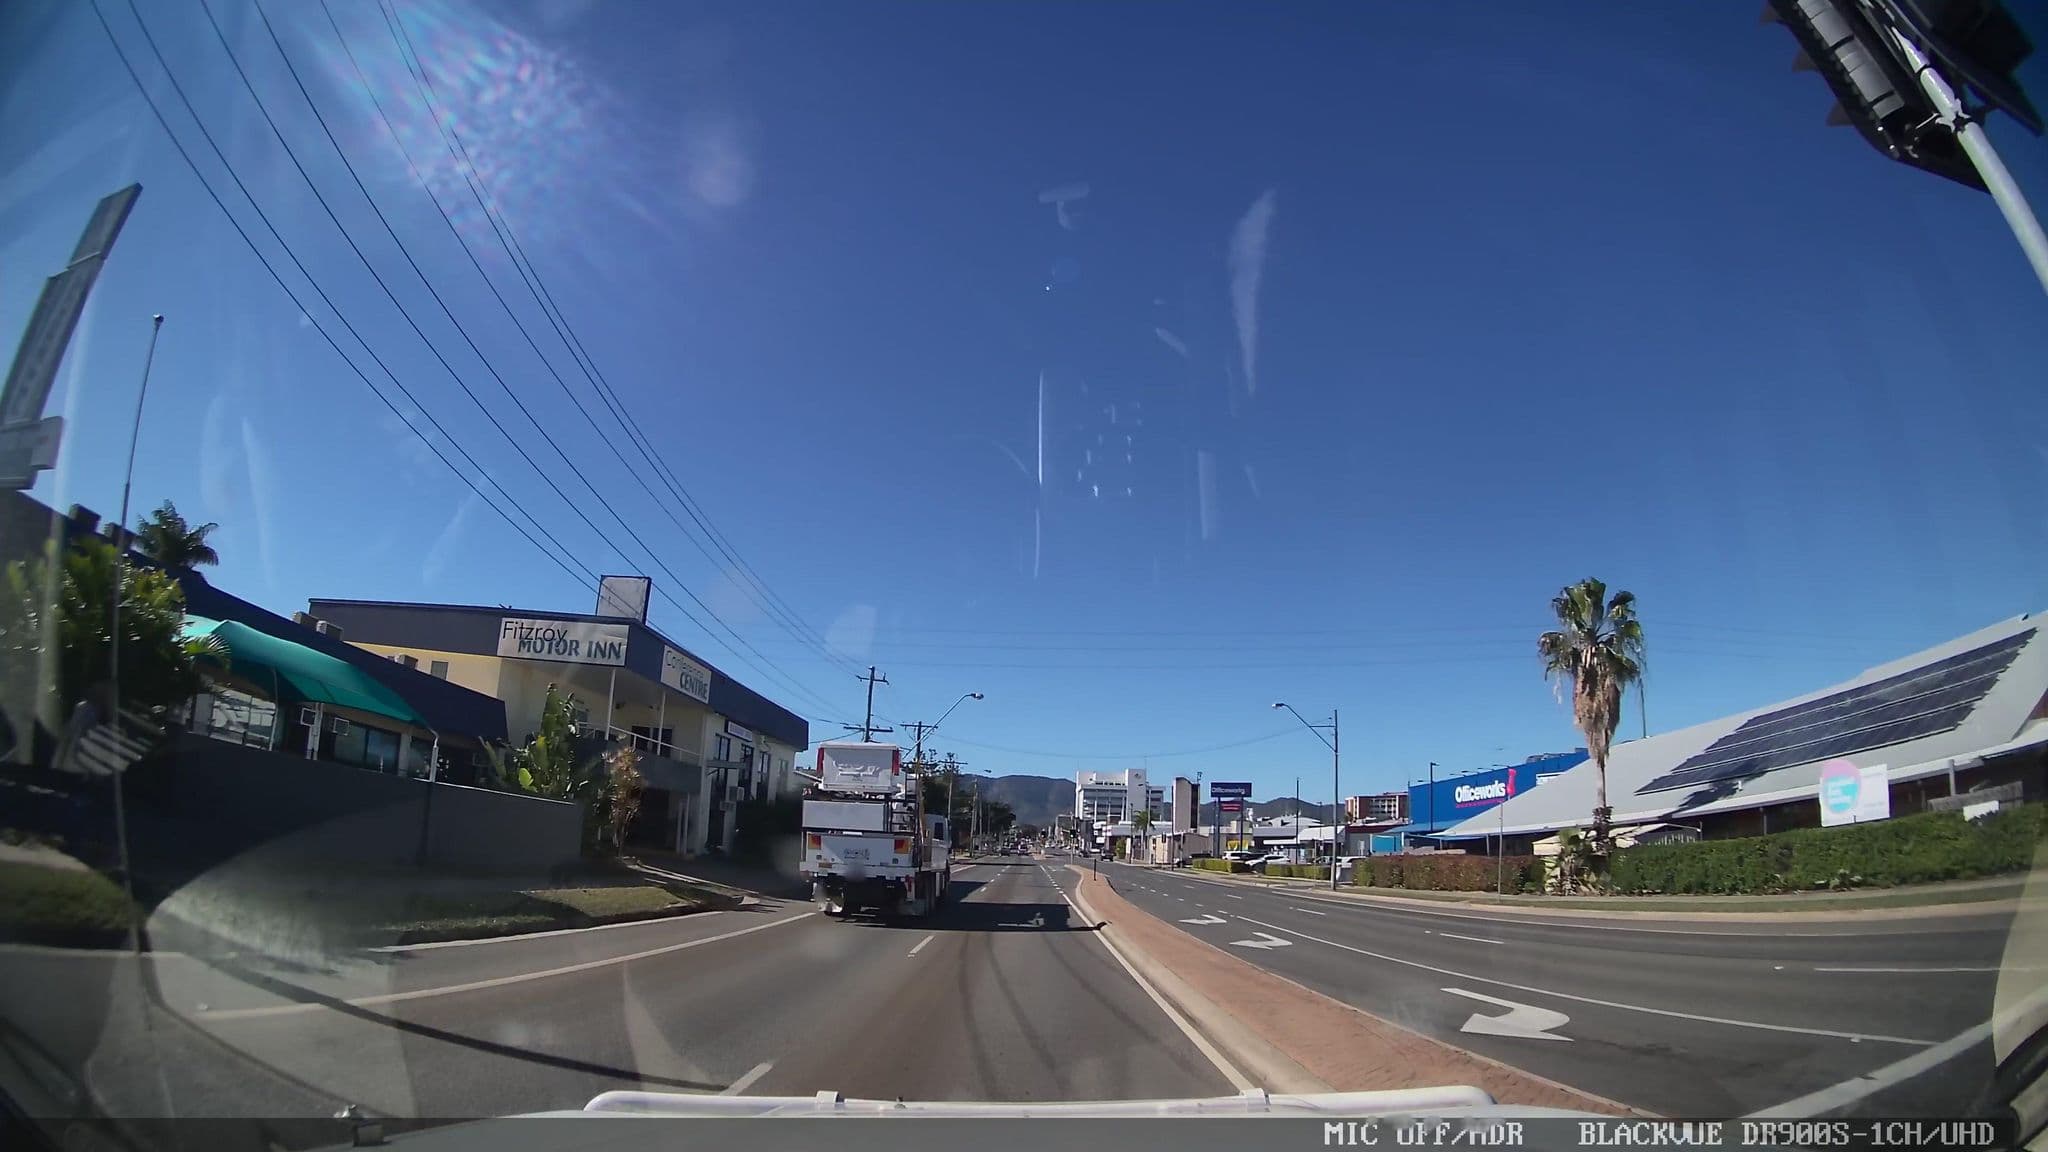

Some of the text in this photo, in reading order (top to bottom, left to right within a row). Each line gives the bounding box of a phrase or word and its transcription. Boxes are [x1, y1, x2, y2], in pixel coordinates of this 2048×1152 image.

[502, 620, 568, 647] Fitzroy
[517, 636, 622, 660] MOTOR INN
[680, 671, 709, 699] CENTRE
[1455, 780, 1506, 803] Officeworks
